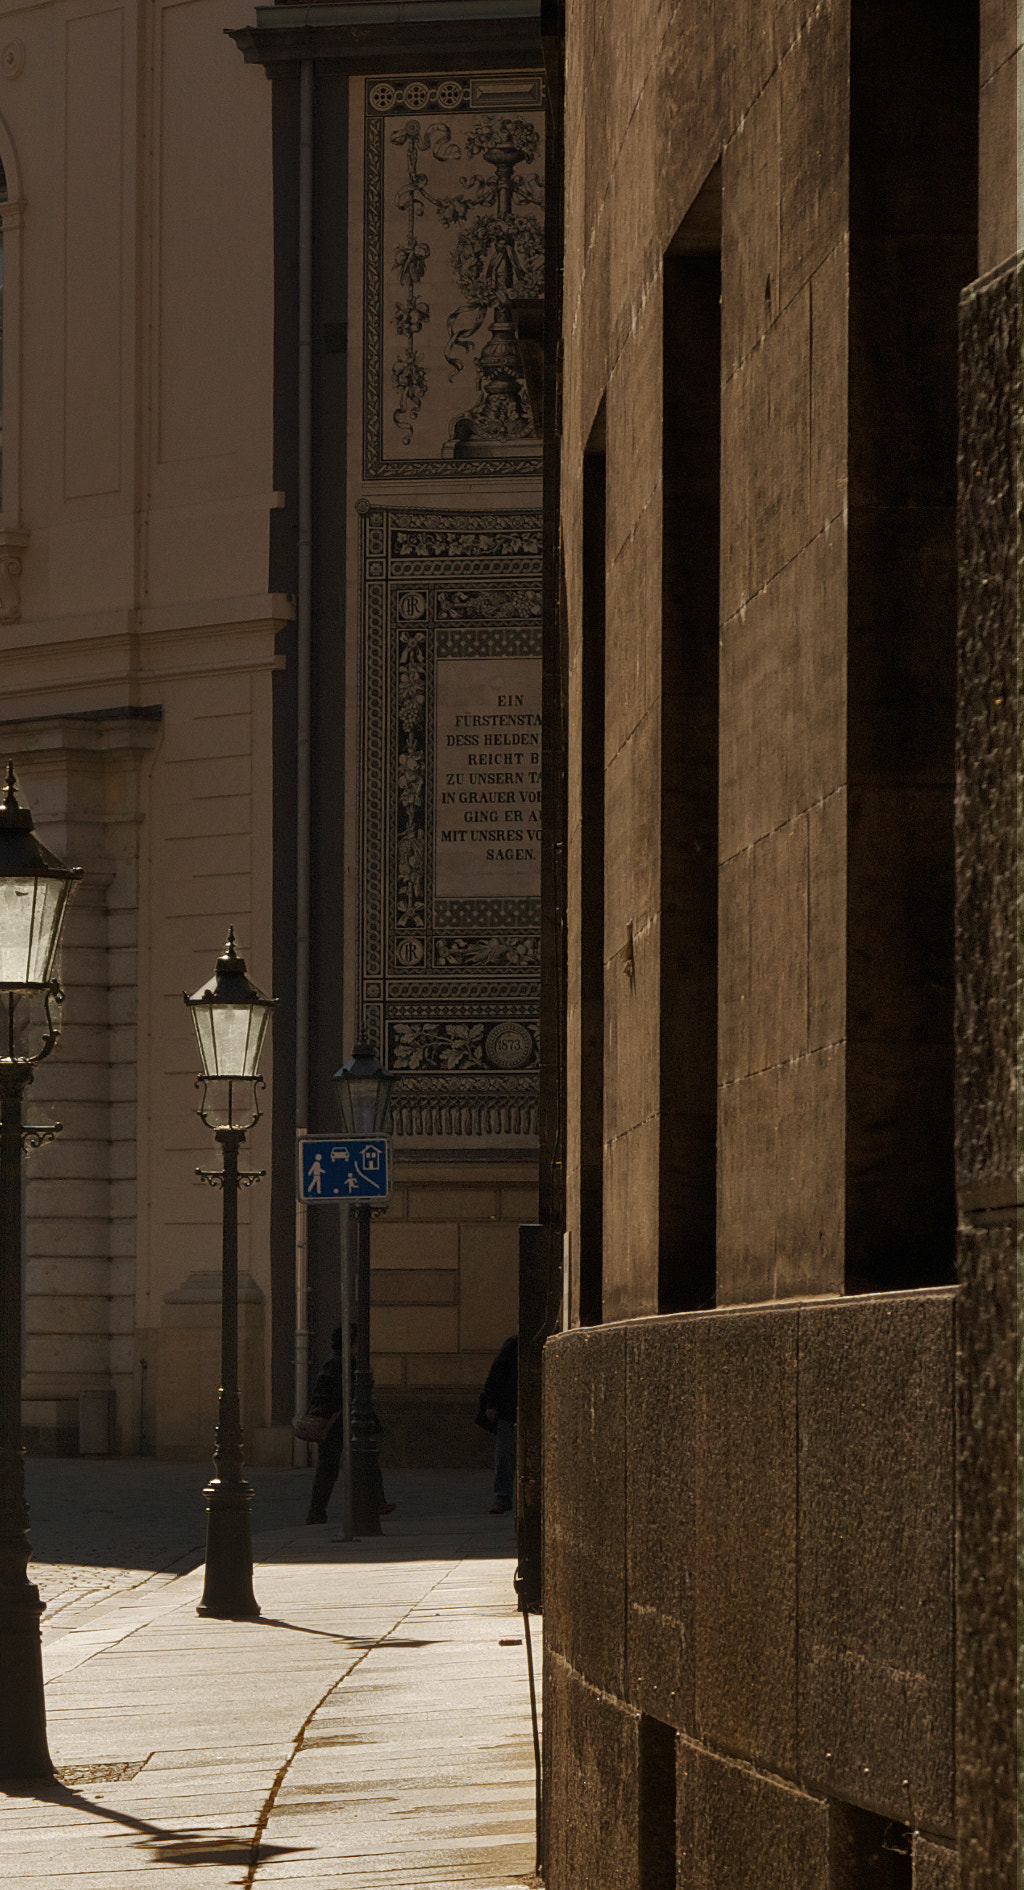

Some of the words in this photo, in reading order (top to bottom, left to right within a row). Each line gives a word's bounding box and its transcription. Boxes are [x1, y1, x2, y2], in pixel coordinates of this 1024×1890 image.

[497, 694, 524, 707] EIN
[446, 734, 479, 746] DESS
[467, 753, 524, 765] REICHT
[446, 773, 464, 785] ZU
[469, 772, 524, 785] UNSERN
[441, 791, 456, 804] IN
[458, 791, 516, 804] GRAUER
[464, 811, 498, 823] GING
[504, 810, 524, 822] ER
[441, 830, 467, 842] MIT
[470, 829, 524, 842] UNSRES
[486, 848, 537, 861] SAGEN.
